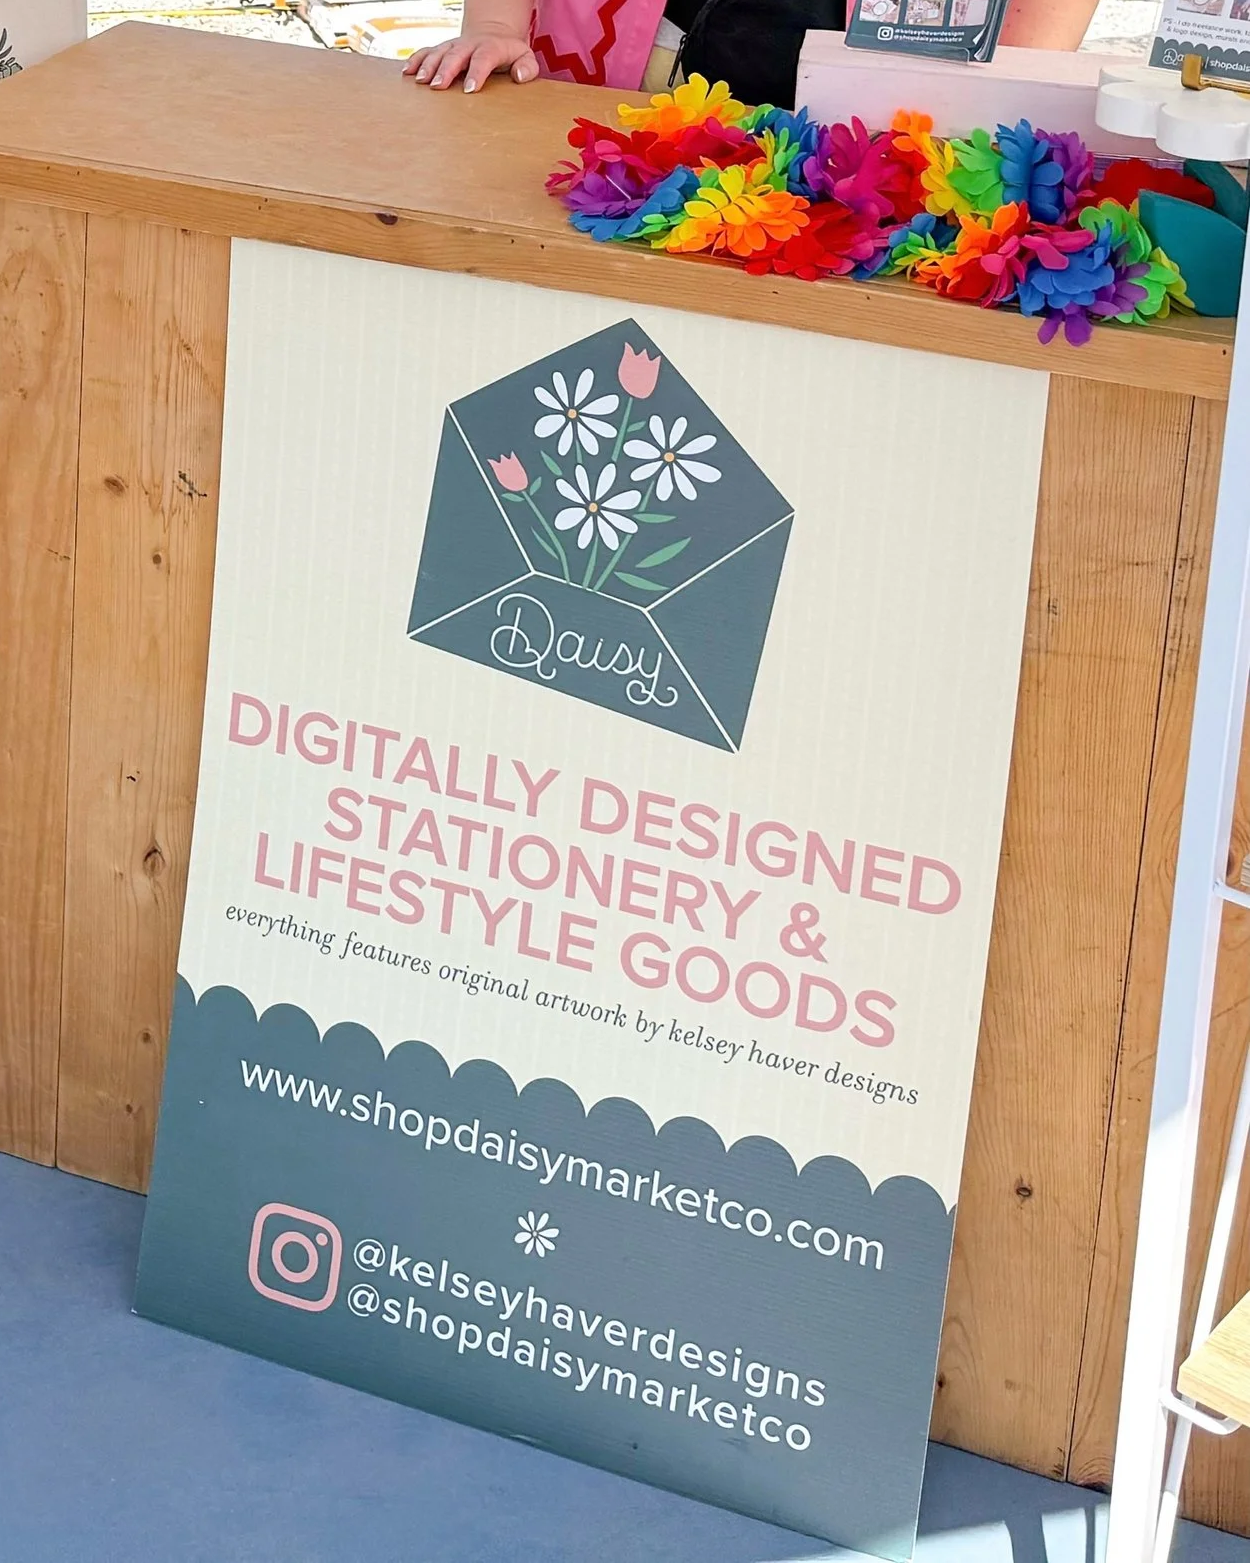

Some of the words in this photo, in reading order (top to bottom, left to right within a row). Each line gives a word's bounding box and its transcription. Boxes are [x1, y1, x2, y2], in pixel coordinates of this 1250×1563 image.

[489, 591, 678, 708] Daisy
[228, 692, 561, 818] DIGITALLY
[580, 776, 962, 915] DESIGNED
[323, 787, 762, 940] STATIONERY
[779, 901, 829, 964] &
[225, 904, 336, 955] everything
[339, 931, 432, 975] features
[438, 957, 530, 1005] original
[534, 987, 628, 1031] artwork
[635, 1009, 664, 1043] by
[668, 1019, 744, 1064] kelsey
[748, 1040, 820, 1078] haver
[824, 1061, 919, 1106] designs
[254, 832, 598, 973] LIFESTYLE
[620, 931, 898, 1048] GOODS
[239, 1058, 886, 1272] www.shopdaisymarketco.com
[346, 1283, 813, 1453] @shopdaisymarketco
[352, 1237, 828, 1410] @kelseyhaverdesigns
